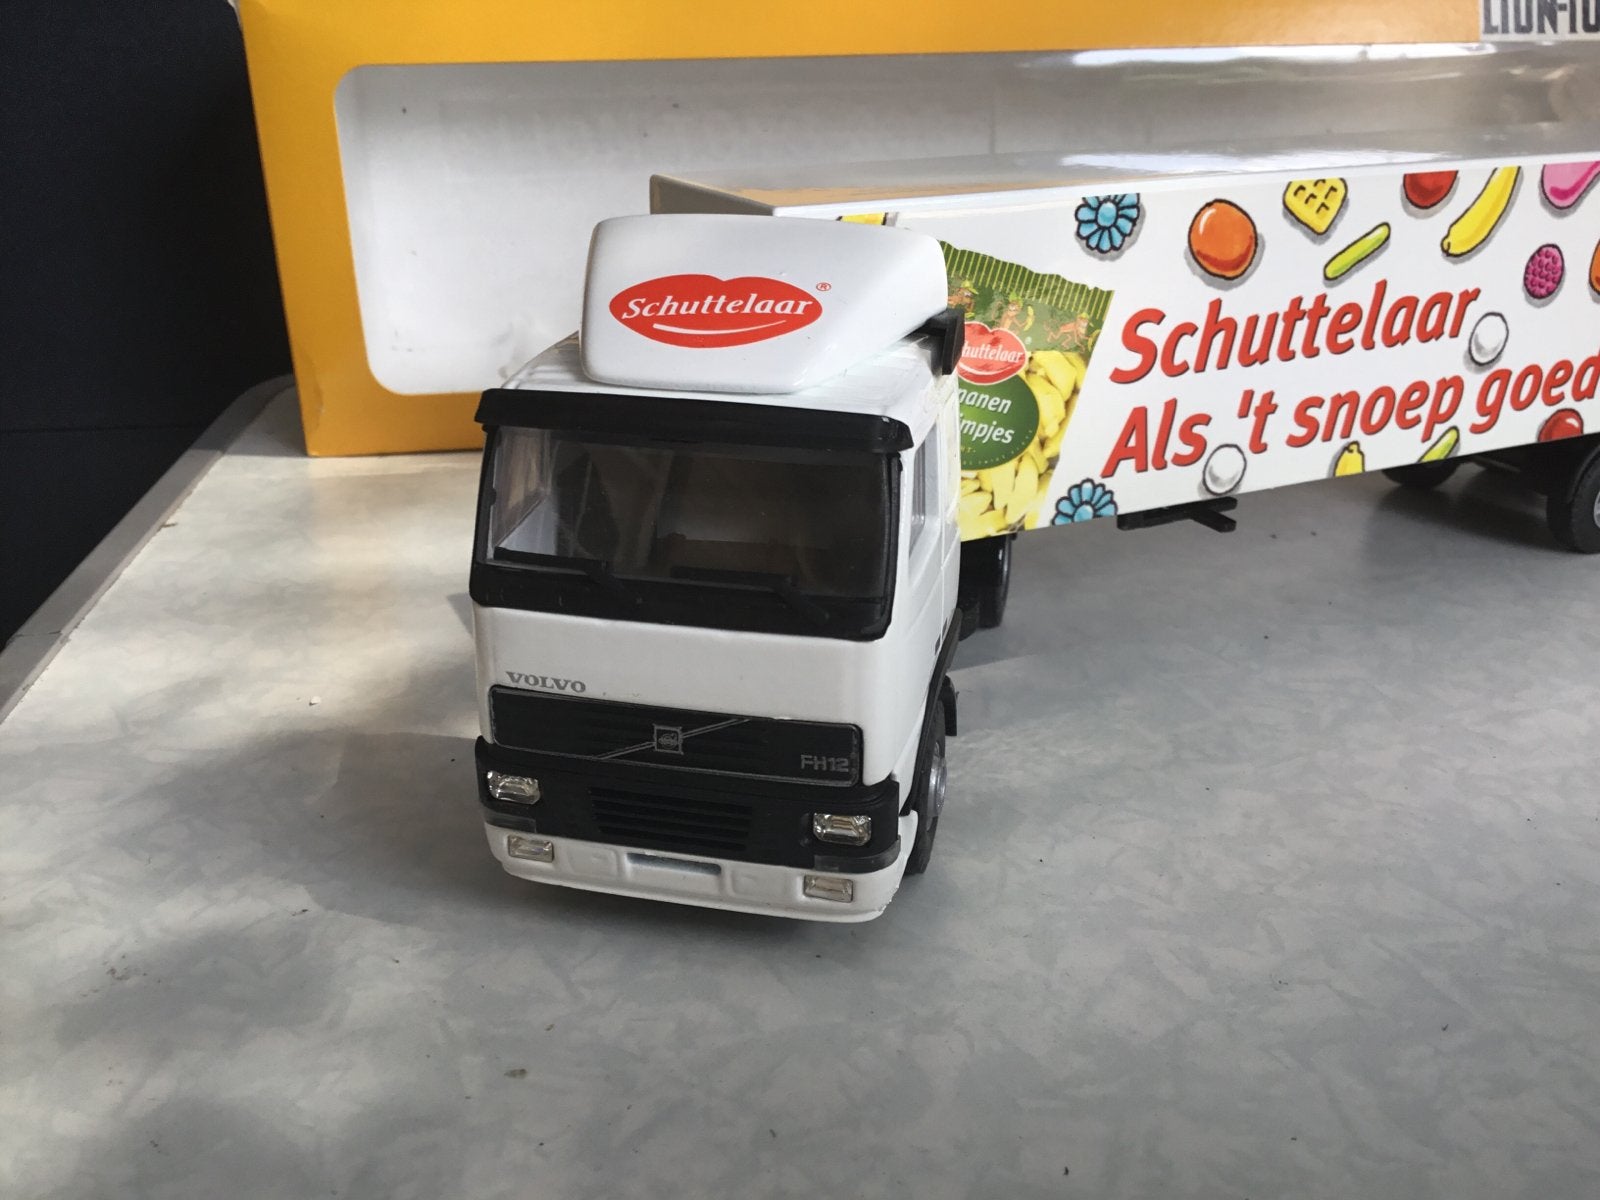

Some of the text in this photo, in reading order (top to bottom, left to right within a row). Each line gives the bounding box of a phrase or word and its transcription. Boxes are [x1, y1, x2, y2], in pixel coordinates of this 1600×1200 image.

[622, 293, 813, 320] Schuttelaar
[1110, 279, 1481, 384] Schuttelaar
[1101, 347, 1600, 478] Als 't snoep goed
[505, 671, 586, 693] VOLVO
[800, 754, 849, 773] FH12
